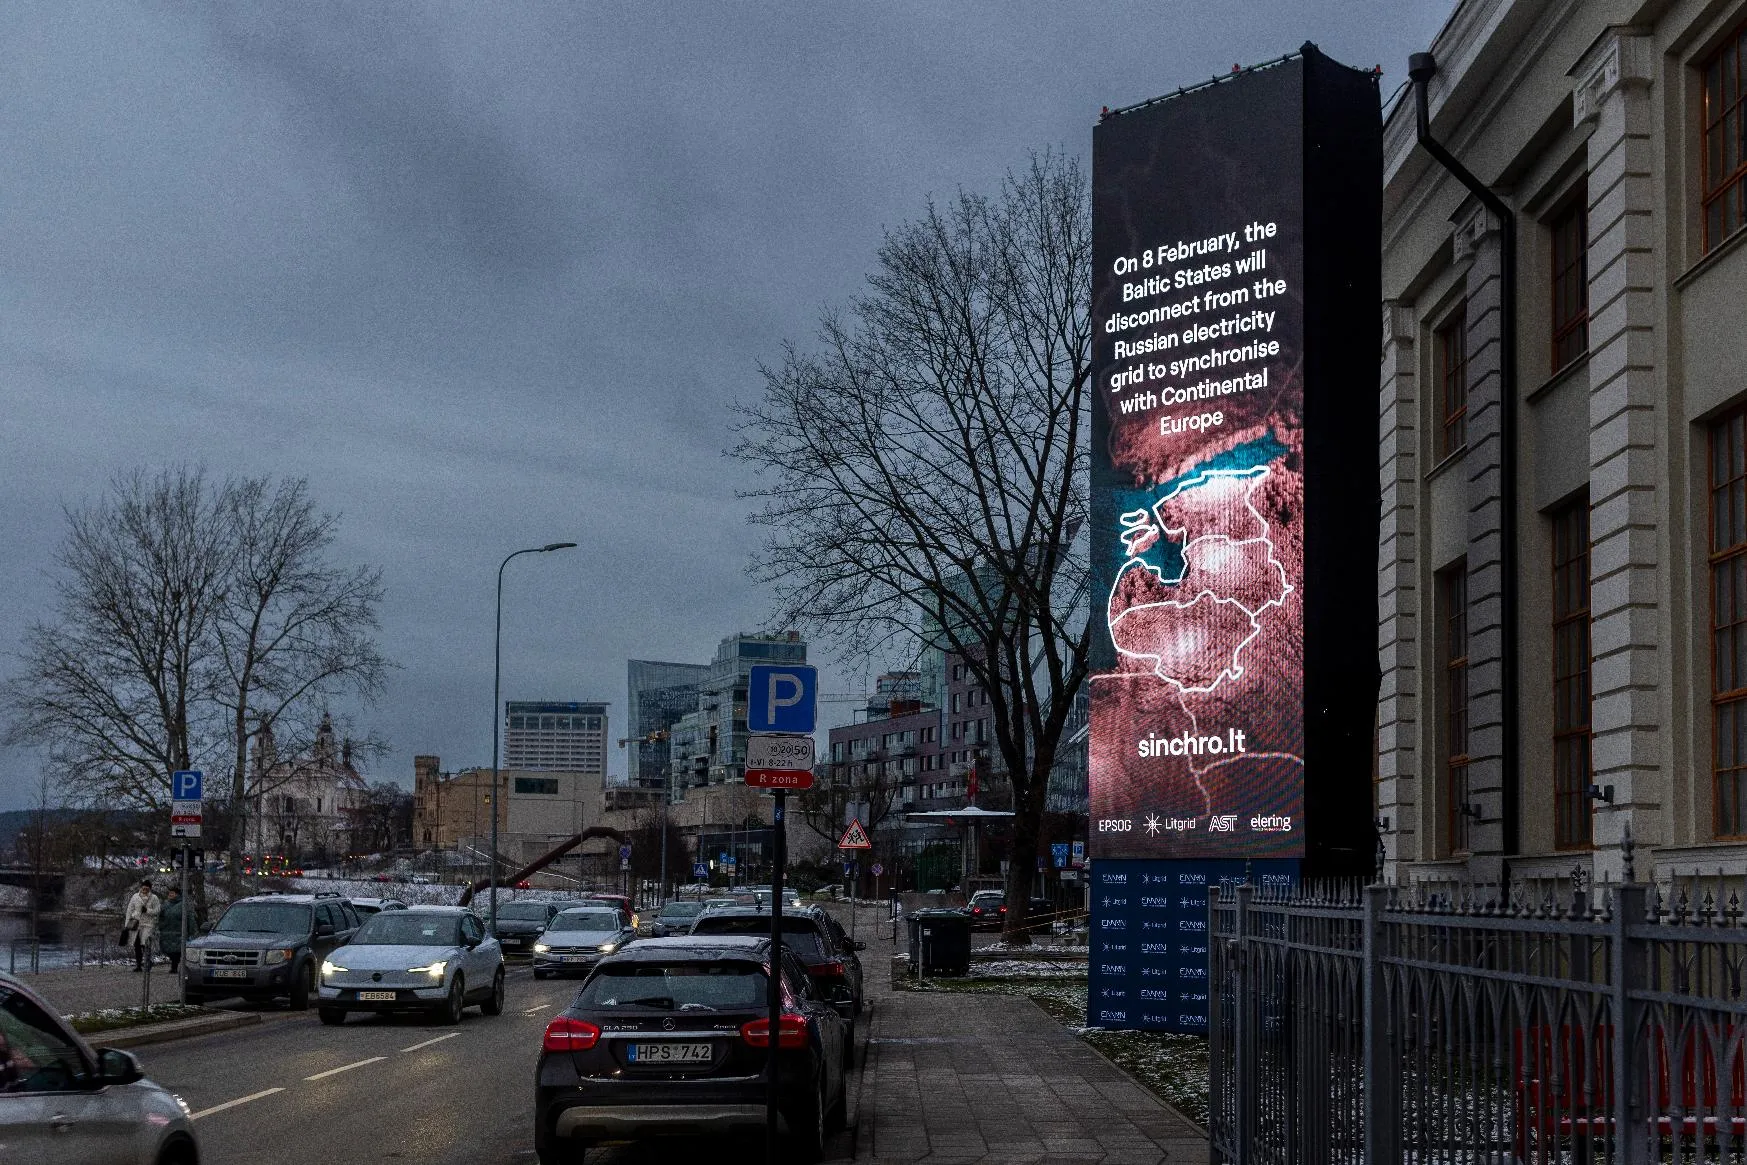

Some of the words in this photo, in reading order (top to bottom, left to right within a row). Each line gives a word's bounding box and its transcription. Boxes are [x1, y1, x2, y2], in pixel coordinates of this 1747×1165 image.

[1113, 257, 1138, 276] On
[1142, 250, 1153, 268] 8
[1158, 231, 1240, 265] February,
[1244, 222, 1277, 242] the
[1123, 276, 1171, 302] Baltic
[1174, 262, 1231, 288] States
[1235, 249, 1266, 274] will
[1105, 295, 1200, 333] disconnect
[1204, 287, 1249, 311] from
[1253, 278, 1287, 299] the
[1114, 332, 1178, 360] Russian
[1182, 310, 1276, 343] electricity
[1110, 364, 1144, 392] grid
[1147, 363, 1167, 379] to
[1170, 339, 1280, 379] synchronise
[1120, 390, 1157, 415] with
[1161, 368, 1268, 406] Continental
[1160, 410, 1224, 436] Europe
[768, 673, 804, 724] P
[780, 745, 792, 754] 20
[794, 745, 808, 756] 50
[1138, 727, 1246, 758] sinchro.lt
[180, 774, 197, 797] P
[760, 773, 767, 783] R
[772, 776, 798, 784] zona
[1099, 820, 1132, 832] EPSOG
[1165, 818, 1196, 832] Litgrid
[1208, 814, 1238, 832] AST
[1250, 814, 1292, 832] elering
[638, 1046, 671, 1060] HPS
[682, 1046, 710, 1059] 742
